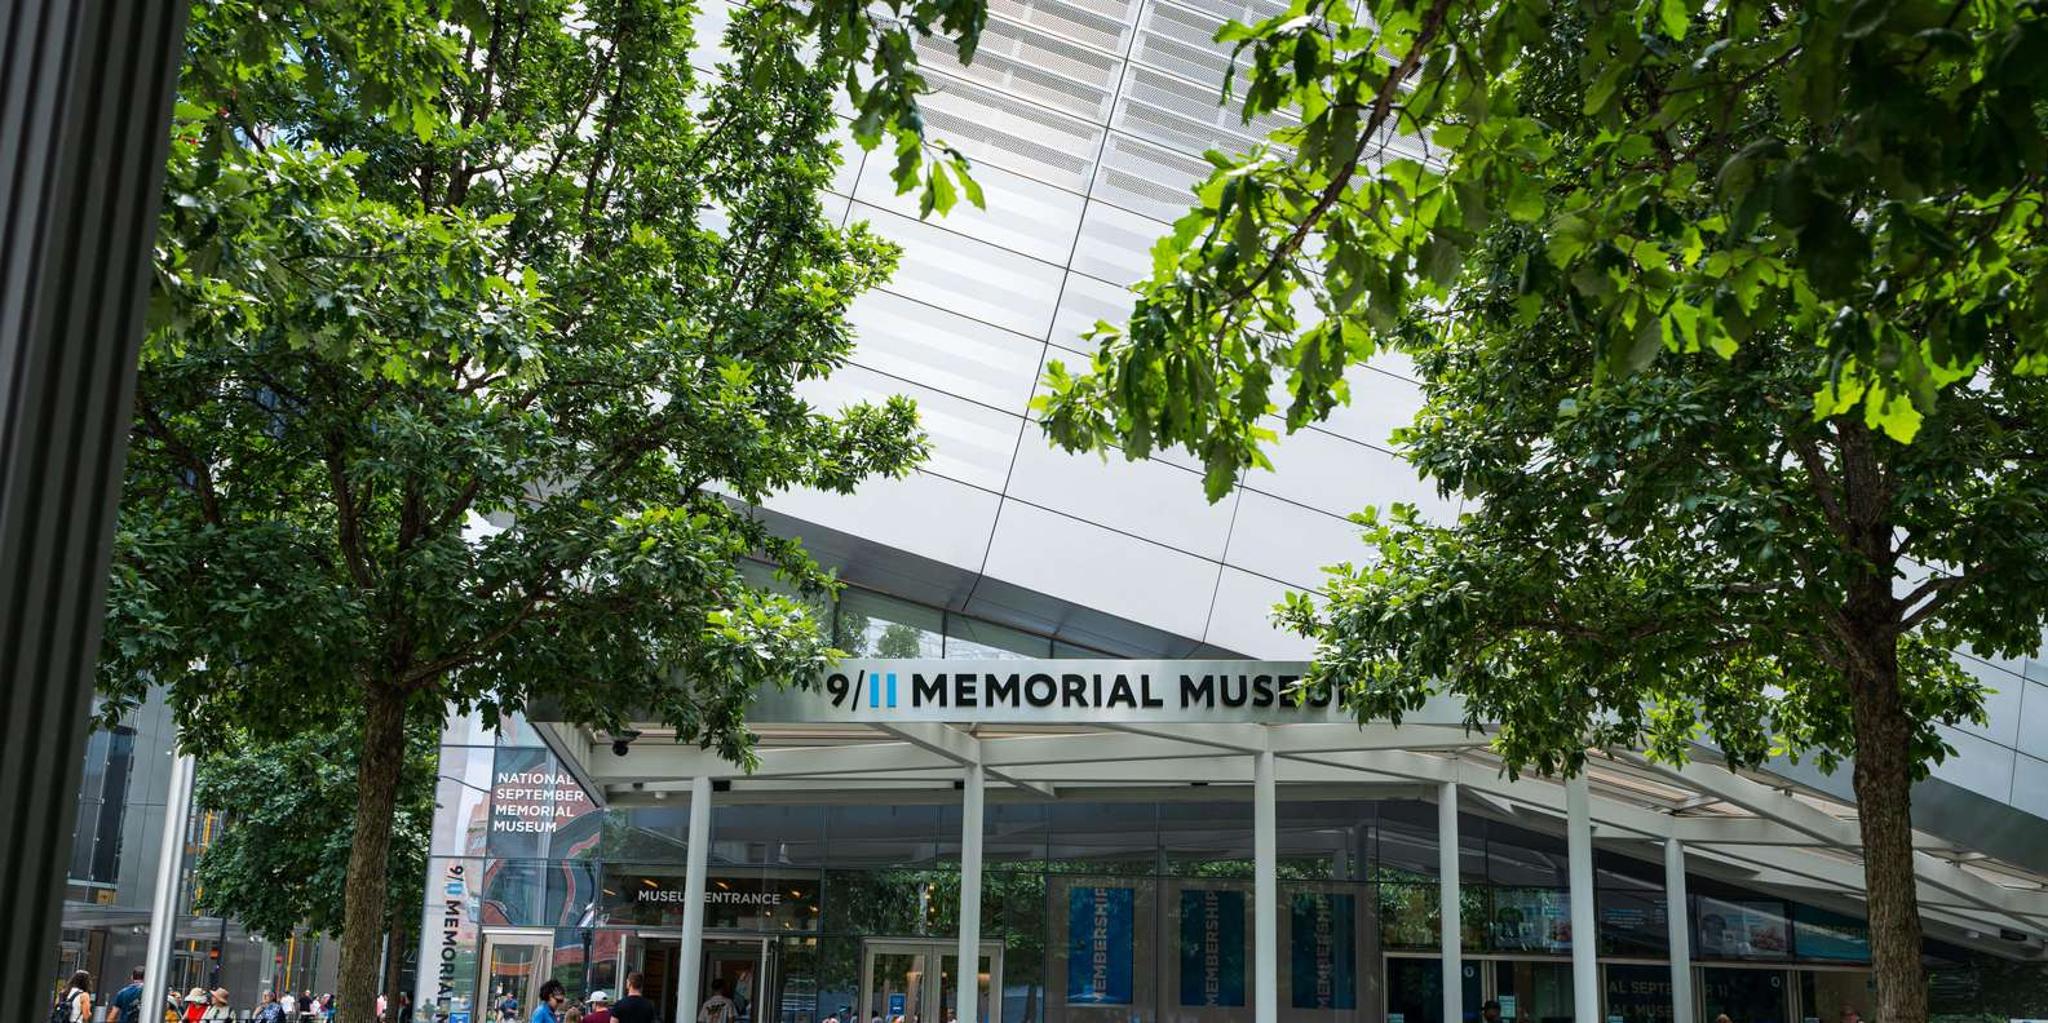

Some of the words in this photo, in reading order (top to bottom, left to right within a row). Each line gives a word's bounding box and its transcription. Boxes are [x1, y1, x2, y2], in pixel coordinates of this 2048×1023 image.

[912, 673, 1163, 708] MEMORIAL
[1179, 674, 1350, 709] MUSEU
[497, 773, 575, 785] NATIONAL
[496, 789, 584, 801] SEPTEMBER
[495, 805, 574, 817] MEMORIAL
[493, 821, 557, 832] MUSEUM
[638, 890, 688, 902] MUSEU
[703, 892, 781, 905] ENTRANCE
[436, 899, 460, 1005] MEMORIAL
